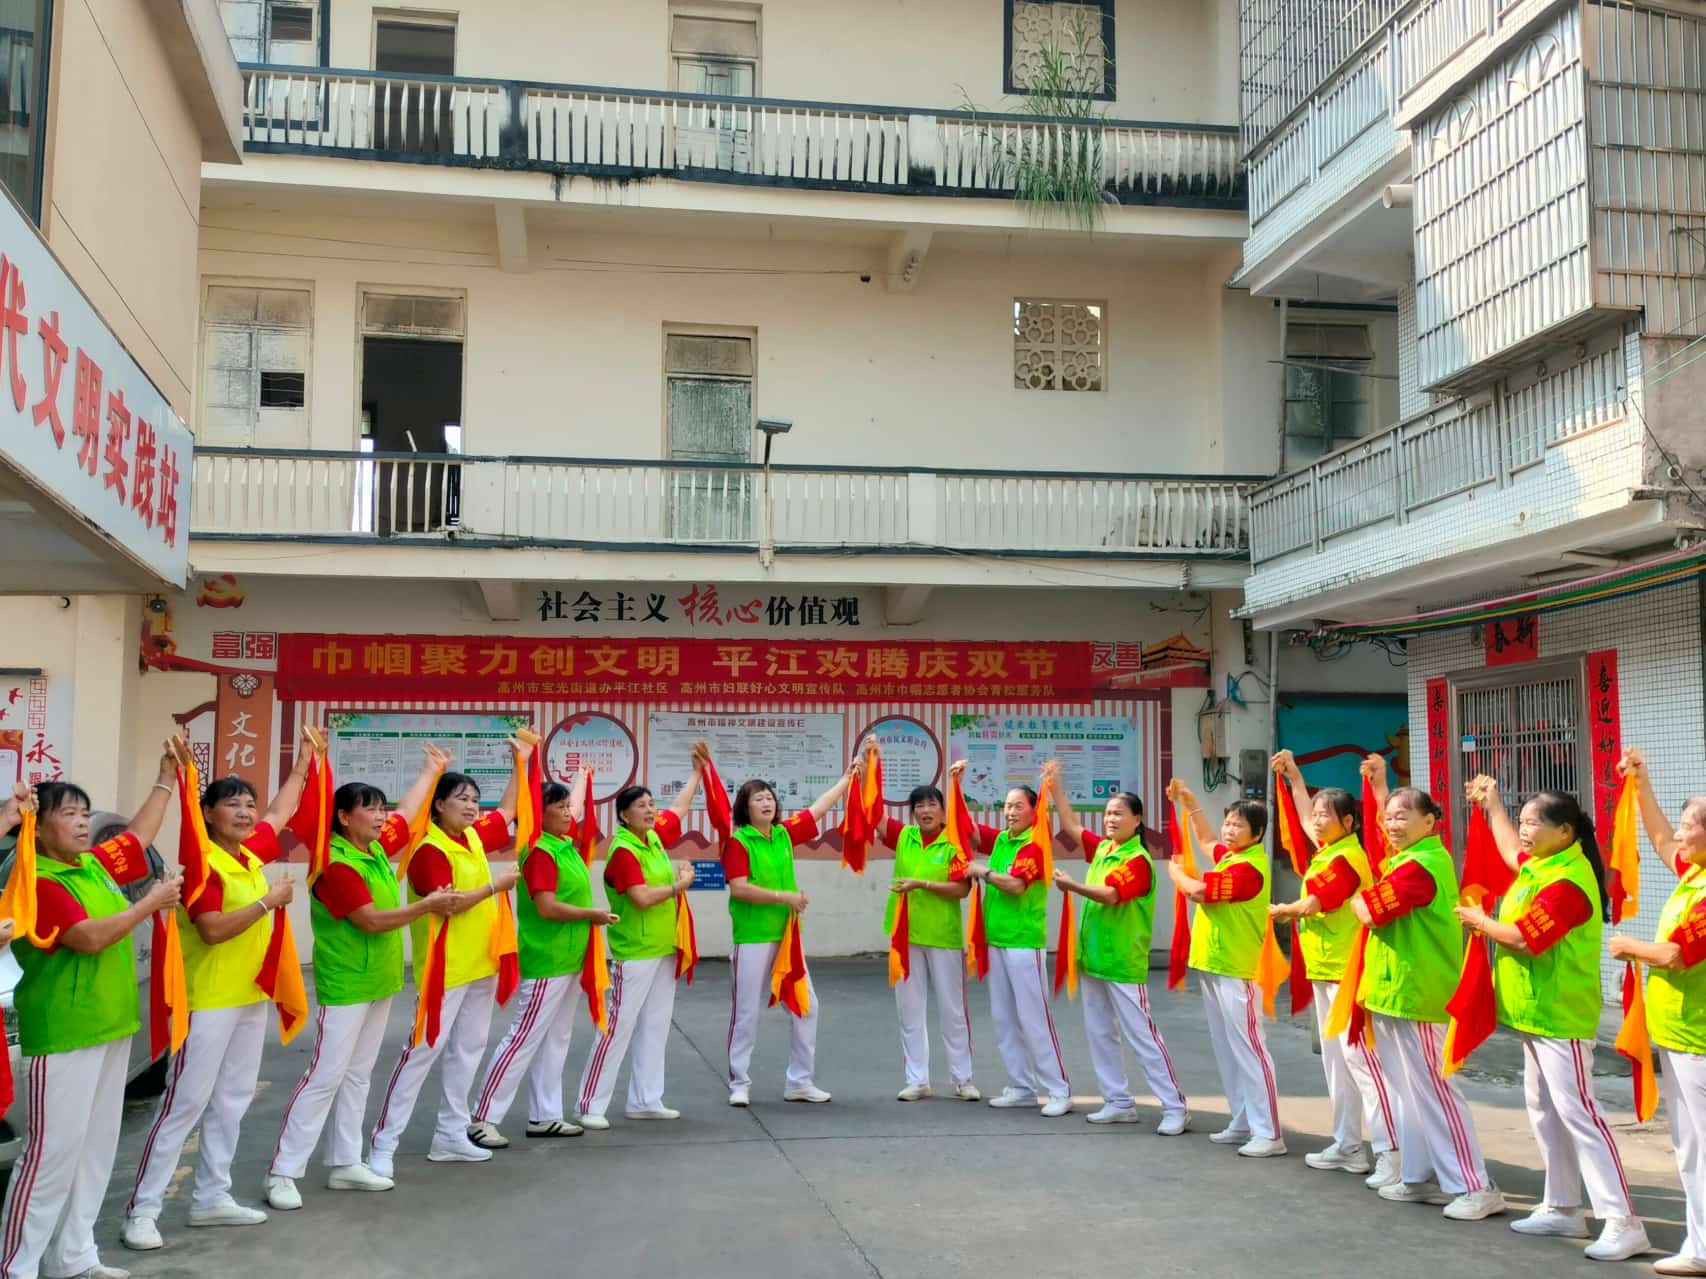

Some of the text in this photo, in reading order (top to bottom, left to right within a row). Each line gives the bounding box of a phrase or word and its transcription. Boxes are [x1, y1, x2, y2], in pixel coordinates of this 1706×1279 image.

[537, 583, 860, 625] 社会主义核心价值观
[212, 631, 276, 660] 富强
[312, 640, 1059, 682] 巾帼聚力创文明 平江欢腾庆双节
[1091, 641, 1141, 671] 友善
[225, 711, 258, 780] 文化
